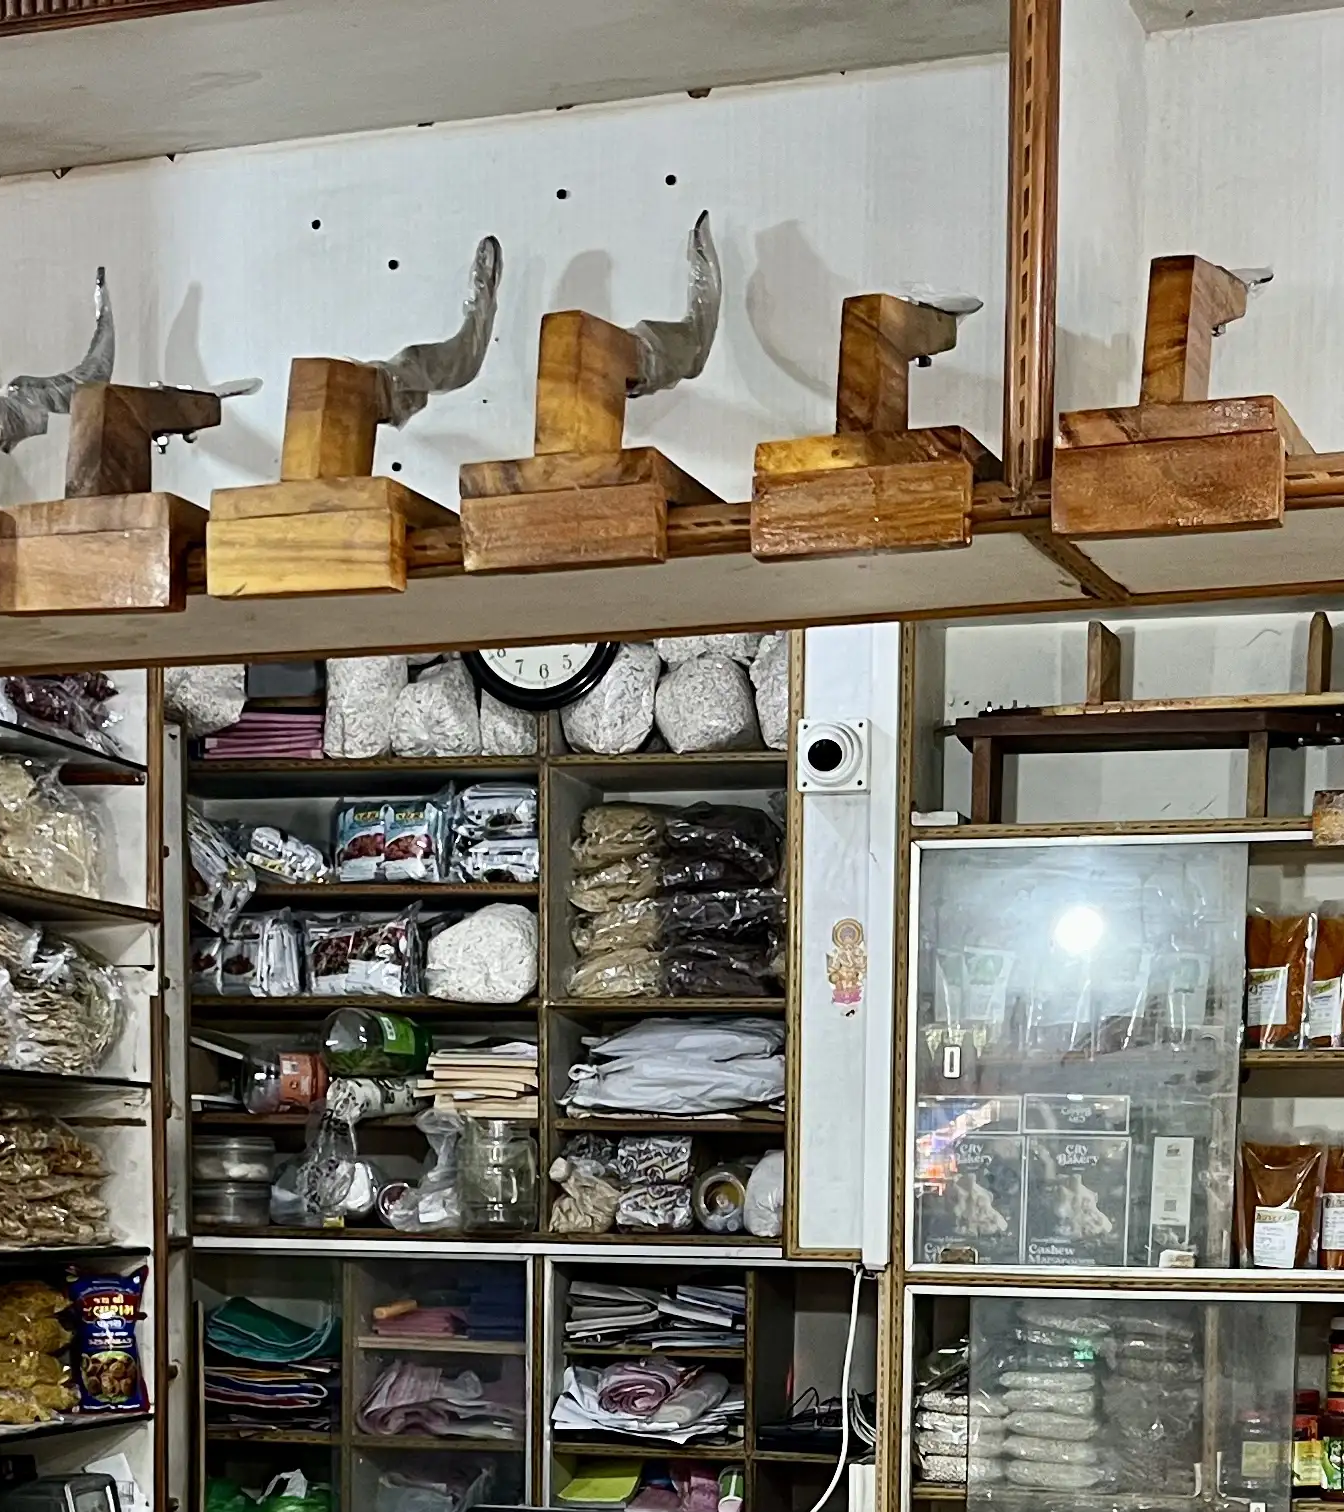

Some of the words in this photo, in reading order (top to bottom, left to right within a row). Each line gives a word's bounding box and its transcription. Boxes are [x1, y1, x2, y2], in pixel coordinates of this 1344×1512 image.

[515, 659, 524, 675] 7
[562, 655, 572, 670] 5
[539, 664, 549, 679] 6
[1056, 1154, 1099, 1166] Bakery
